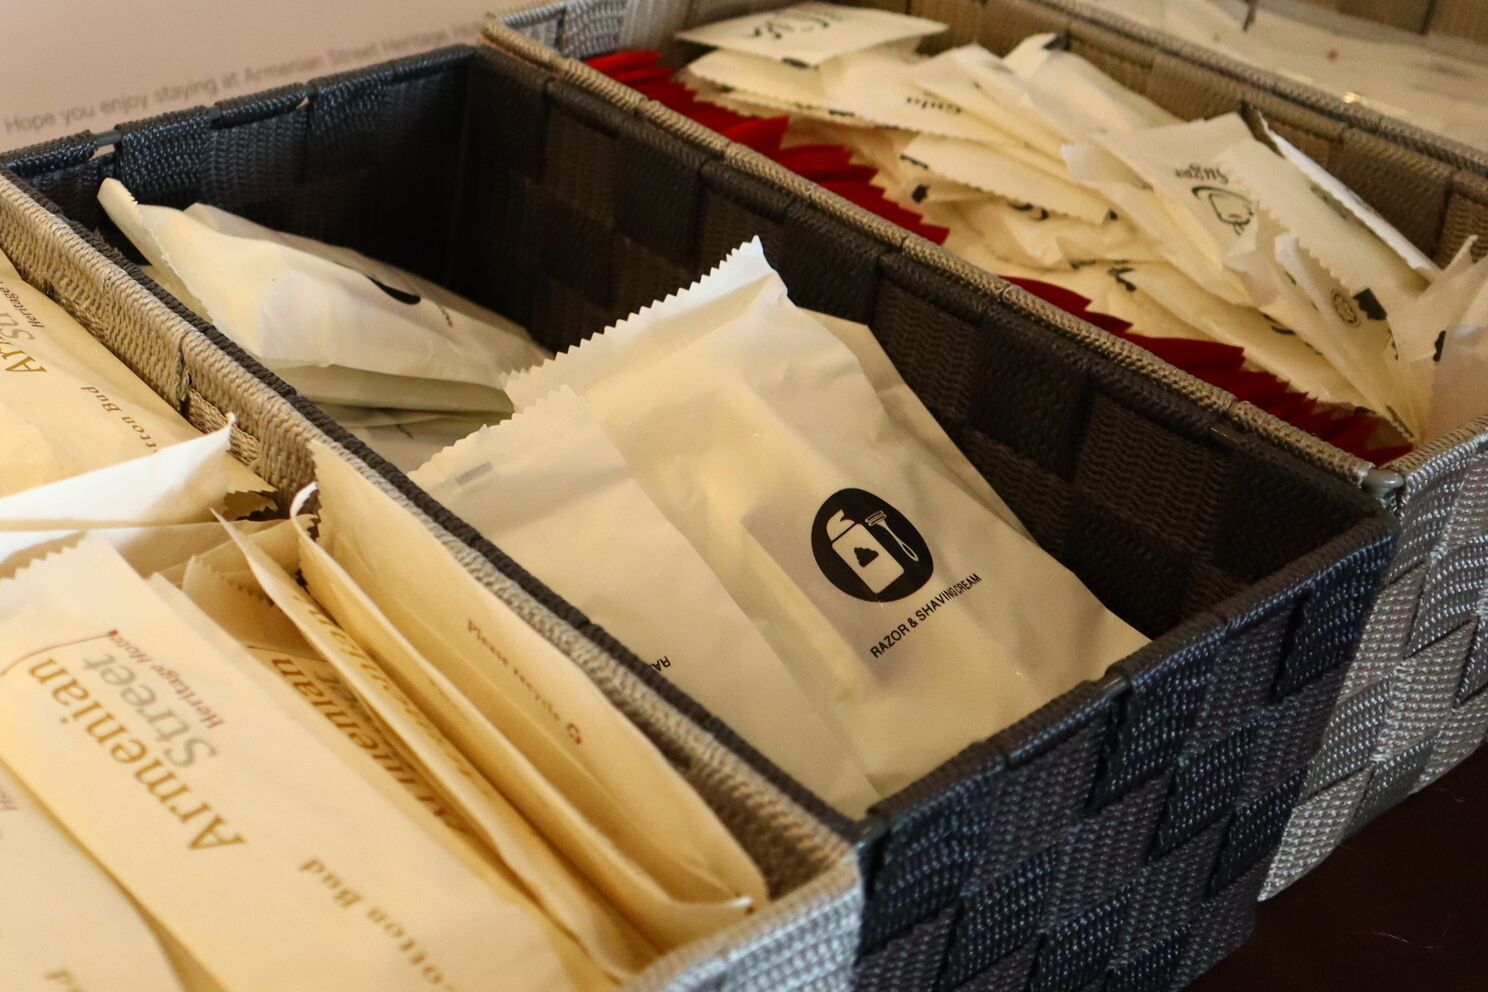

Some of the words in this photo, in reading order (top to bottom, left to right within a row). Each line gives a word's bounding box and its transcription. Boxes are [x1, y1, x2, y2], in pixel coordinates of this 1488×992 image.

[5, 113, 55, 134] Hope
[59, 104, 94, 128] you
[100, 91, 148, 116] enjoy
[153, 77, 215, 105] staying
[222, 70, 240, 87] at
[81, 385, 122, 413] Bud
[870, 623, 911, 658] RAZOR
[907, 617, 919, 629] &
[82, 653, 219, 769] Street
[149, 658, 225, 729] Heritage
[28, 657, 248, 852] Armenian
[299, 857, 363, 909] Bud
